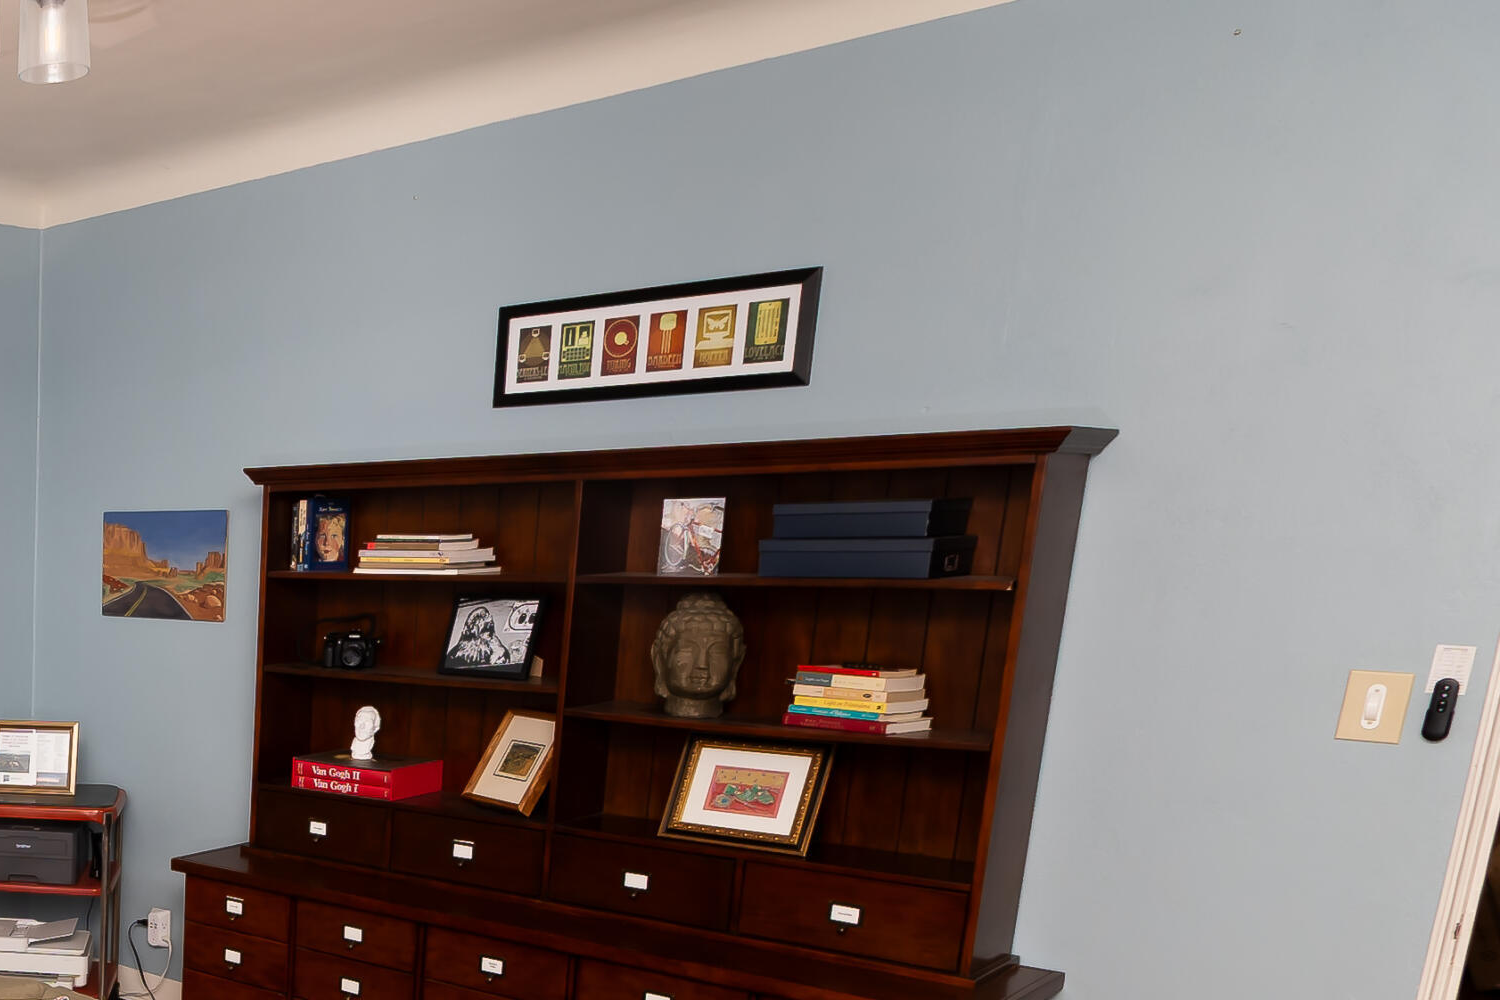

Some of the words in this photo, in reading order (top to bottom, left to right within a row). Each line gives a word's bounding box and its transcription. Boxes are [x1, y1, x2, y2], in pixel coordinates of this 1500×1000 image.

[311, 765, 327, 776] Van
[328, 767, 351, 780] Gogh
[352, 770, 361, 781] II
[313, 778, 329, 789] Van
[330, 780, 352, 793] Gogh
[353, 783, 360, 793] I
